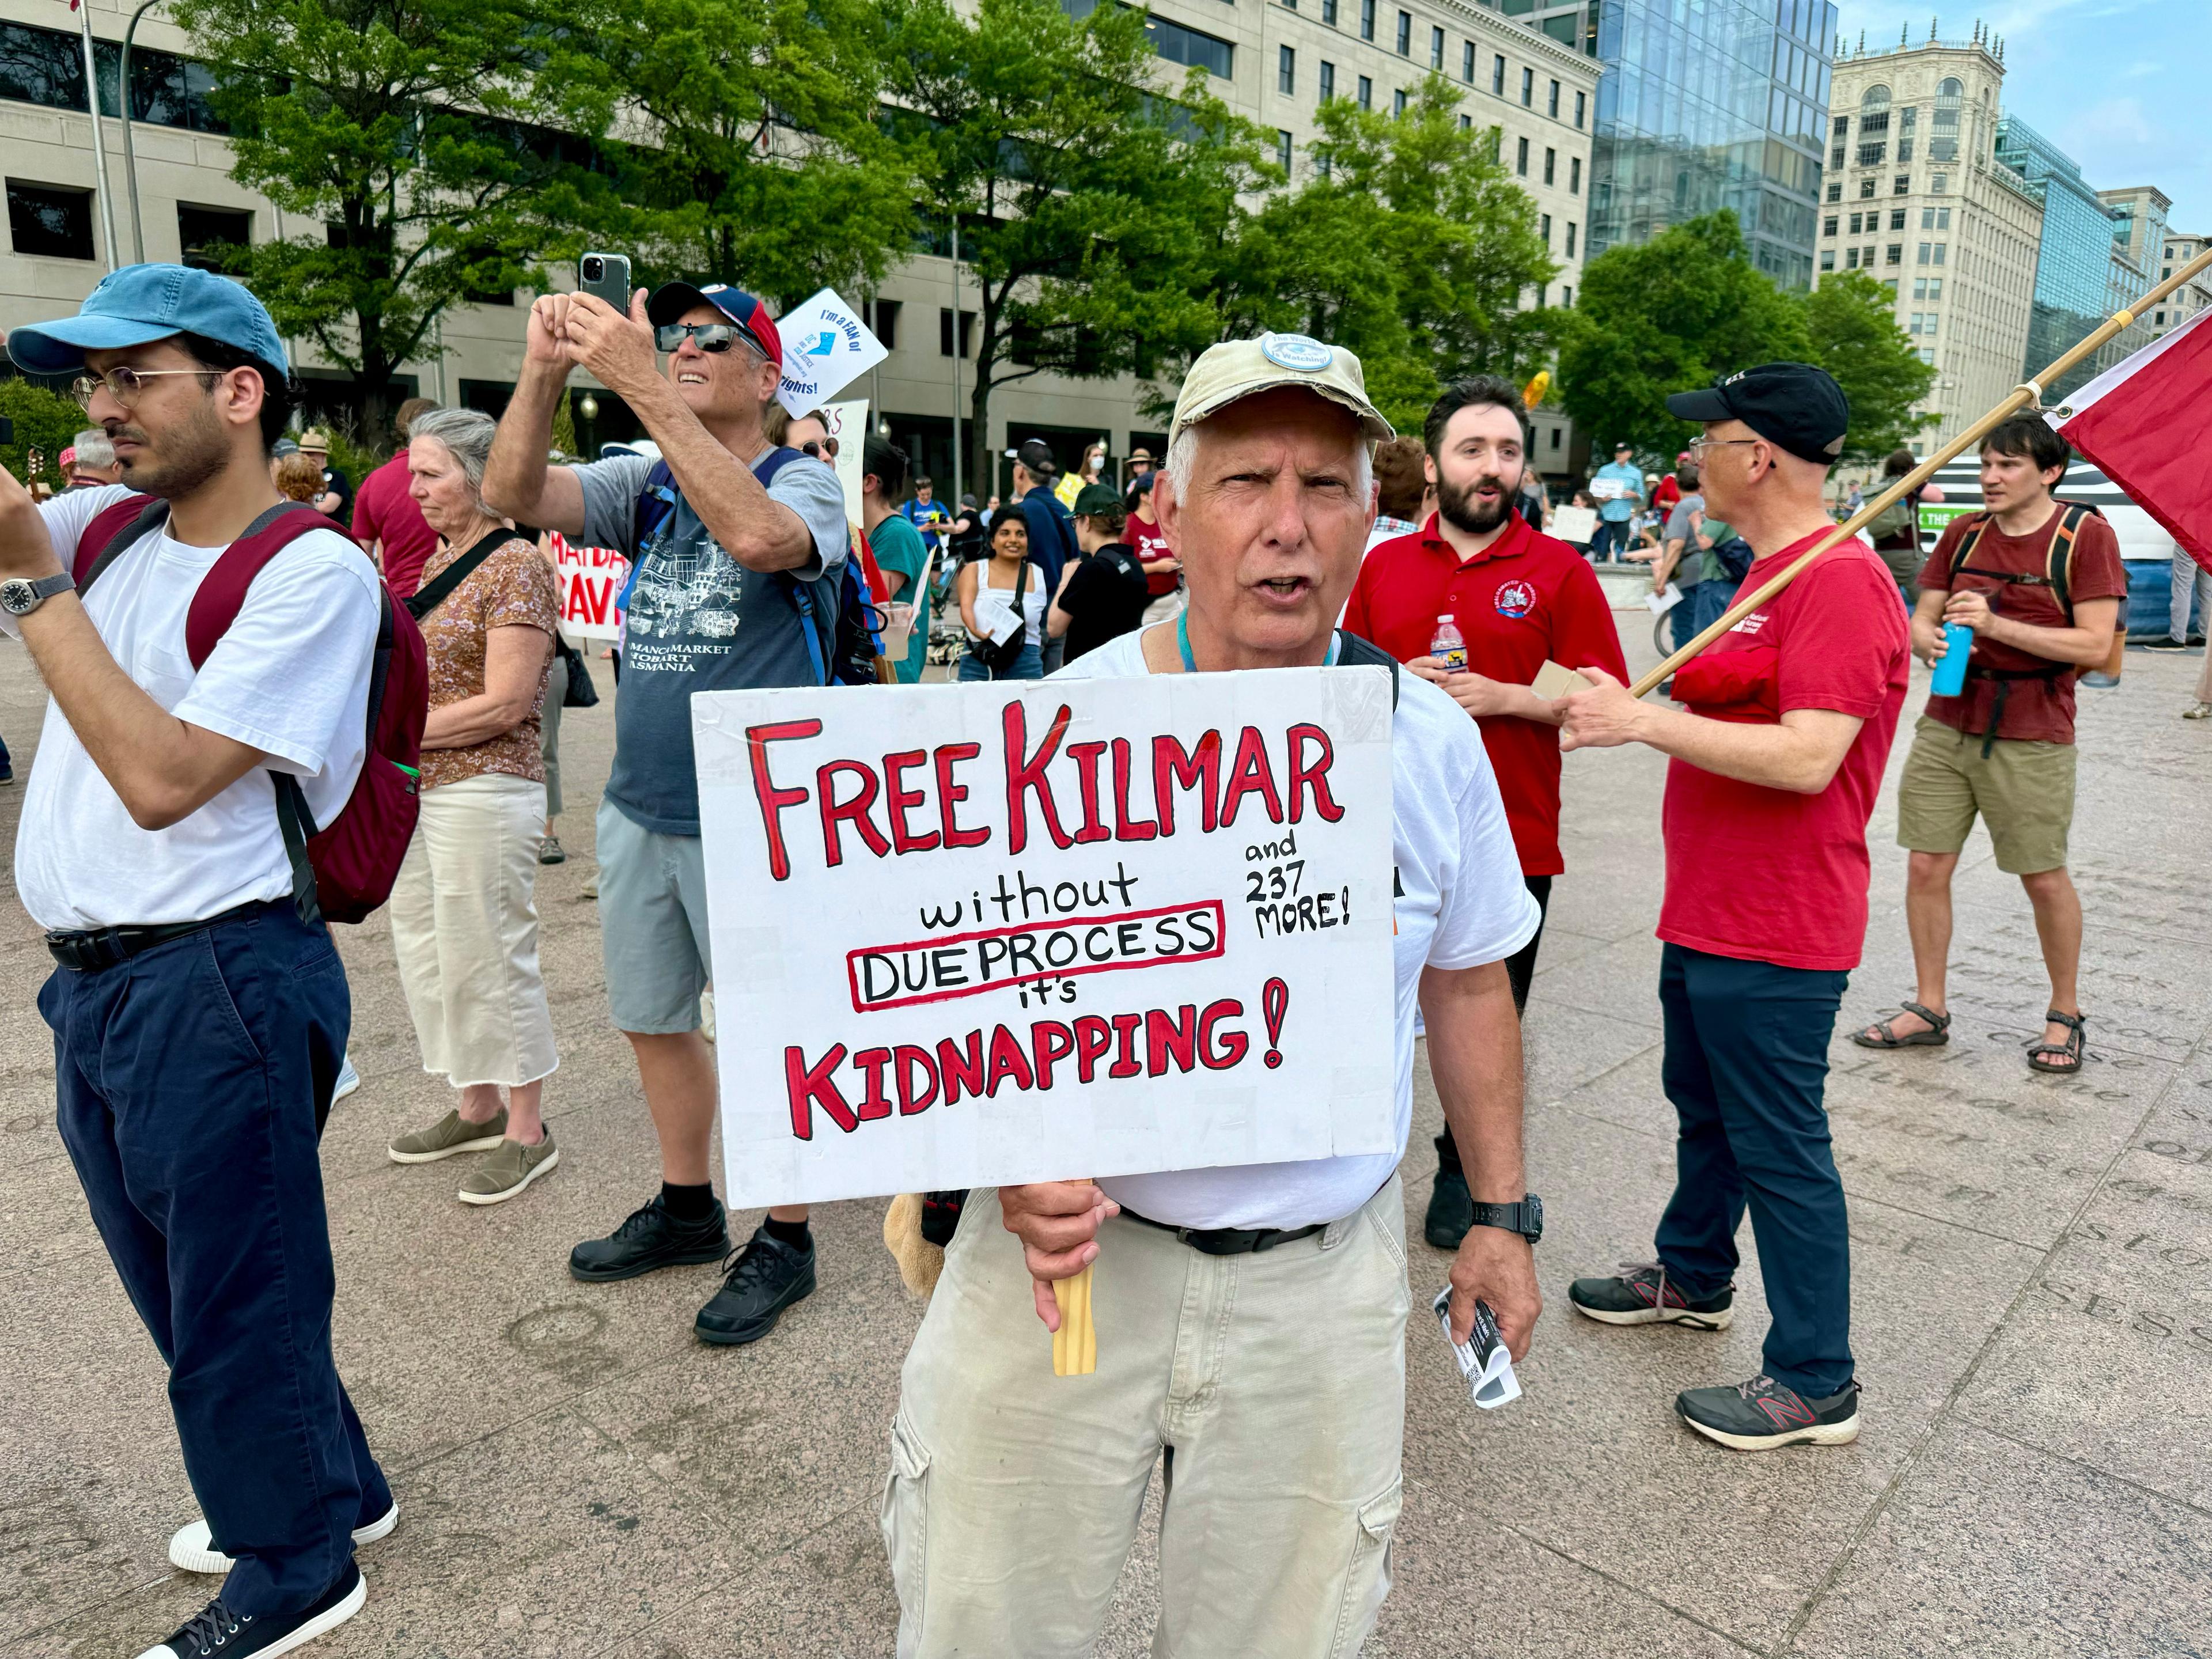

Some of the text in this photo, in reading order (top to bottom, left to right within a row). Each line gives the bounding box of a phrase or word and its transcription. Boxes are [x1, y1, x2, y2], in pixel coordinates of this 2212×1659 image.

[820, 309, 861, 351] I'm a FAN of
[1290, 336, 1316, 346] World
[1281, 353, 1327, 363] Watching!
[781, 376, 817, 395] rights!
[1926, 513, 1950, 525] THE
[671, 644, 732, 654] MARKET
[745, 699, 1346, 881] FREE KILMAR
[1246, 829, 1296, 861] and
[921, 862, 1138, 929] without
[1247, 860, 1305, 903] 237
[1256, 886, 1350, 939] MORE!
[862, 910, 1216, 1003] DUE PROCESS
[1018, 975, 1077, 1009] it's
[785, 977, 1289, 1142] KIDNAPPING!
